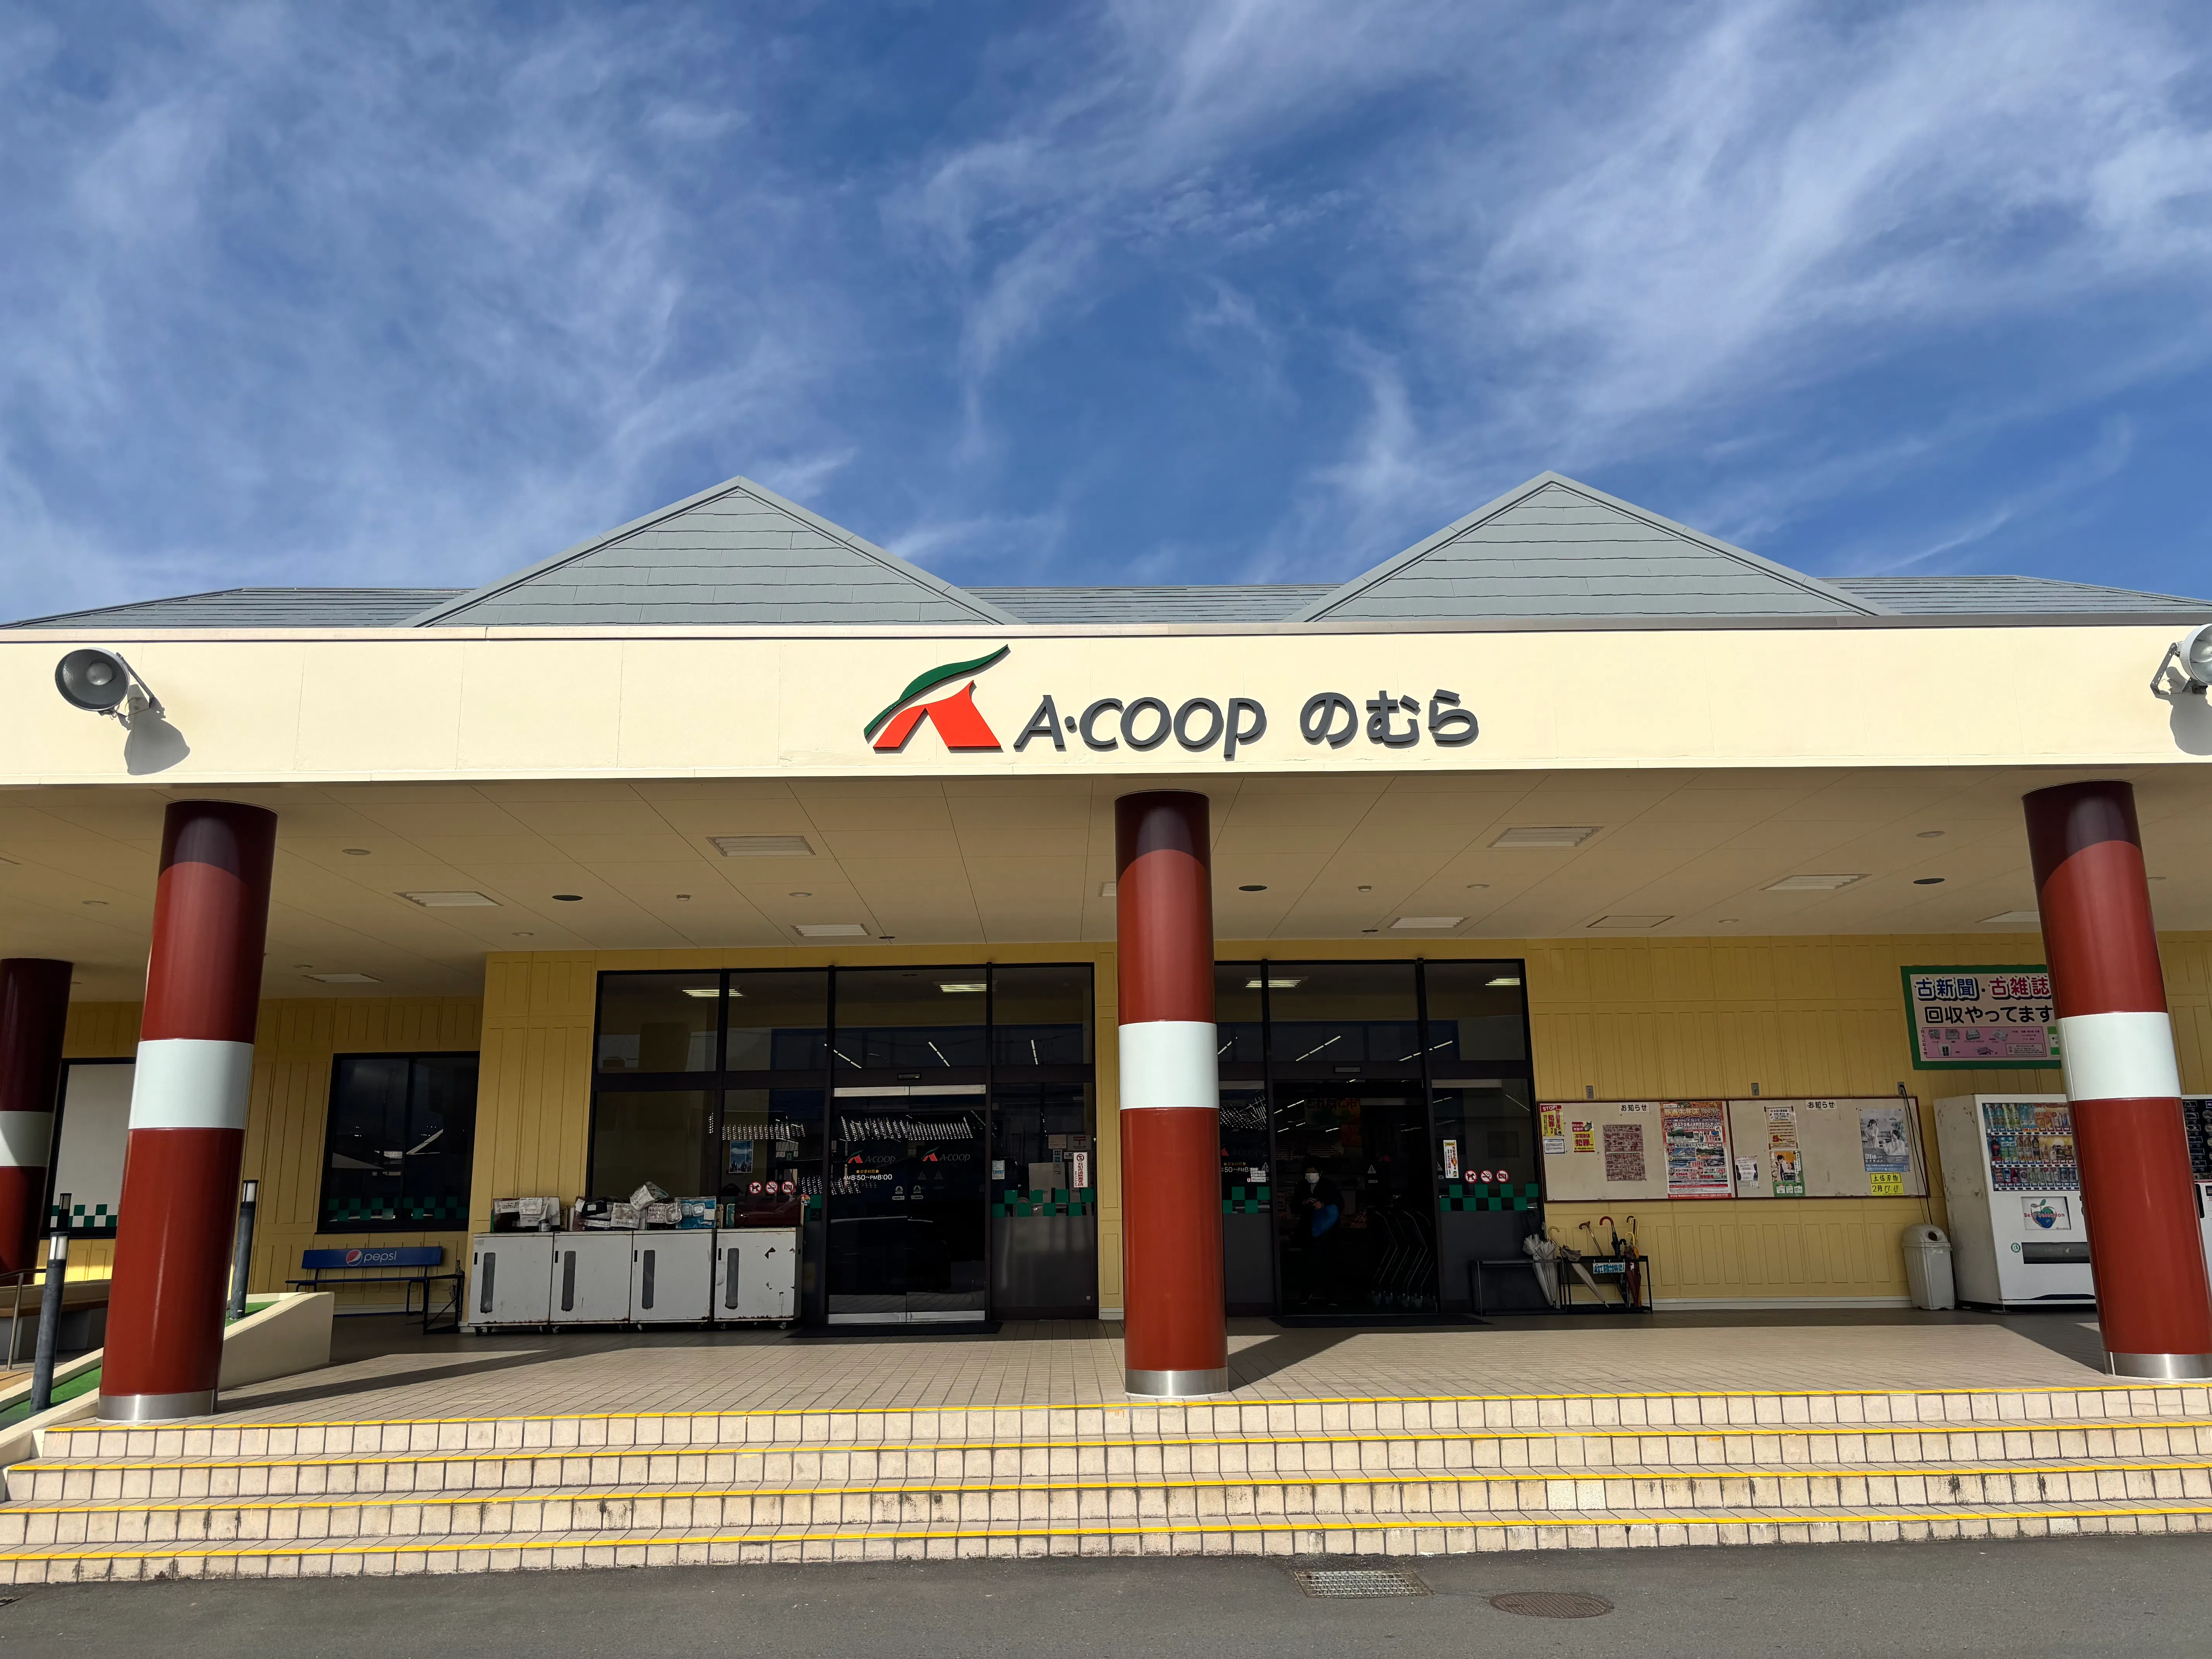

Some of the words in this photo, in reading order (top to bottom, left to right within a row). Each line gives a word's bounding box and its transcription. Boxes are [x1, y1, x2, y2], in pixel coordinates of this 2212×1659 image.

[1300, 689, 1479, 747] のむら
[1924, 1005, 2053, 1024] 回収やってます
[364, 1250, 397, 1263] pepsi
